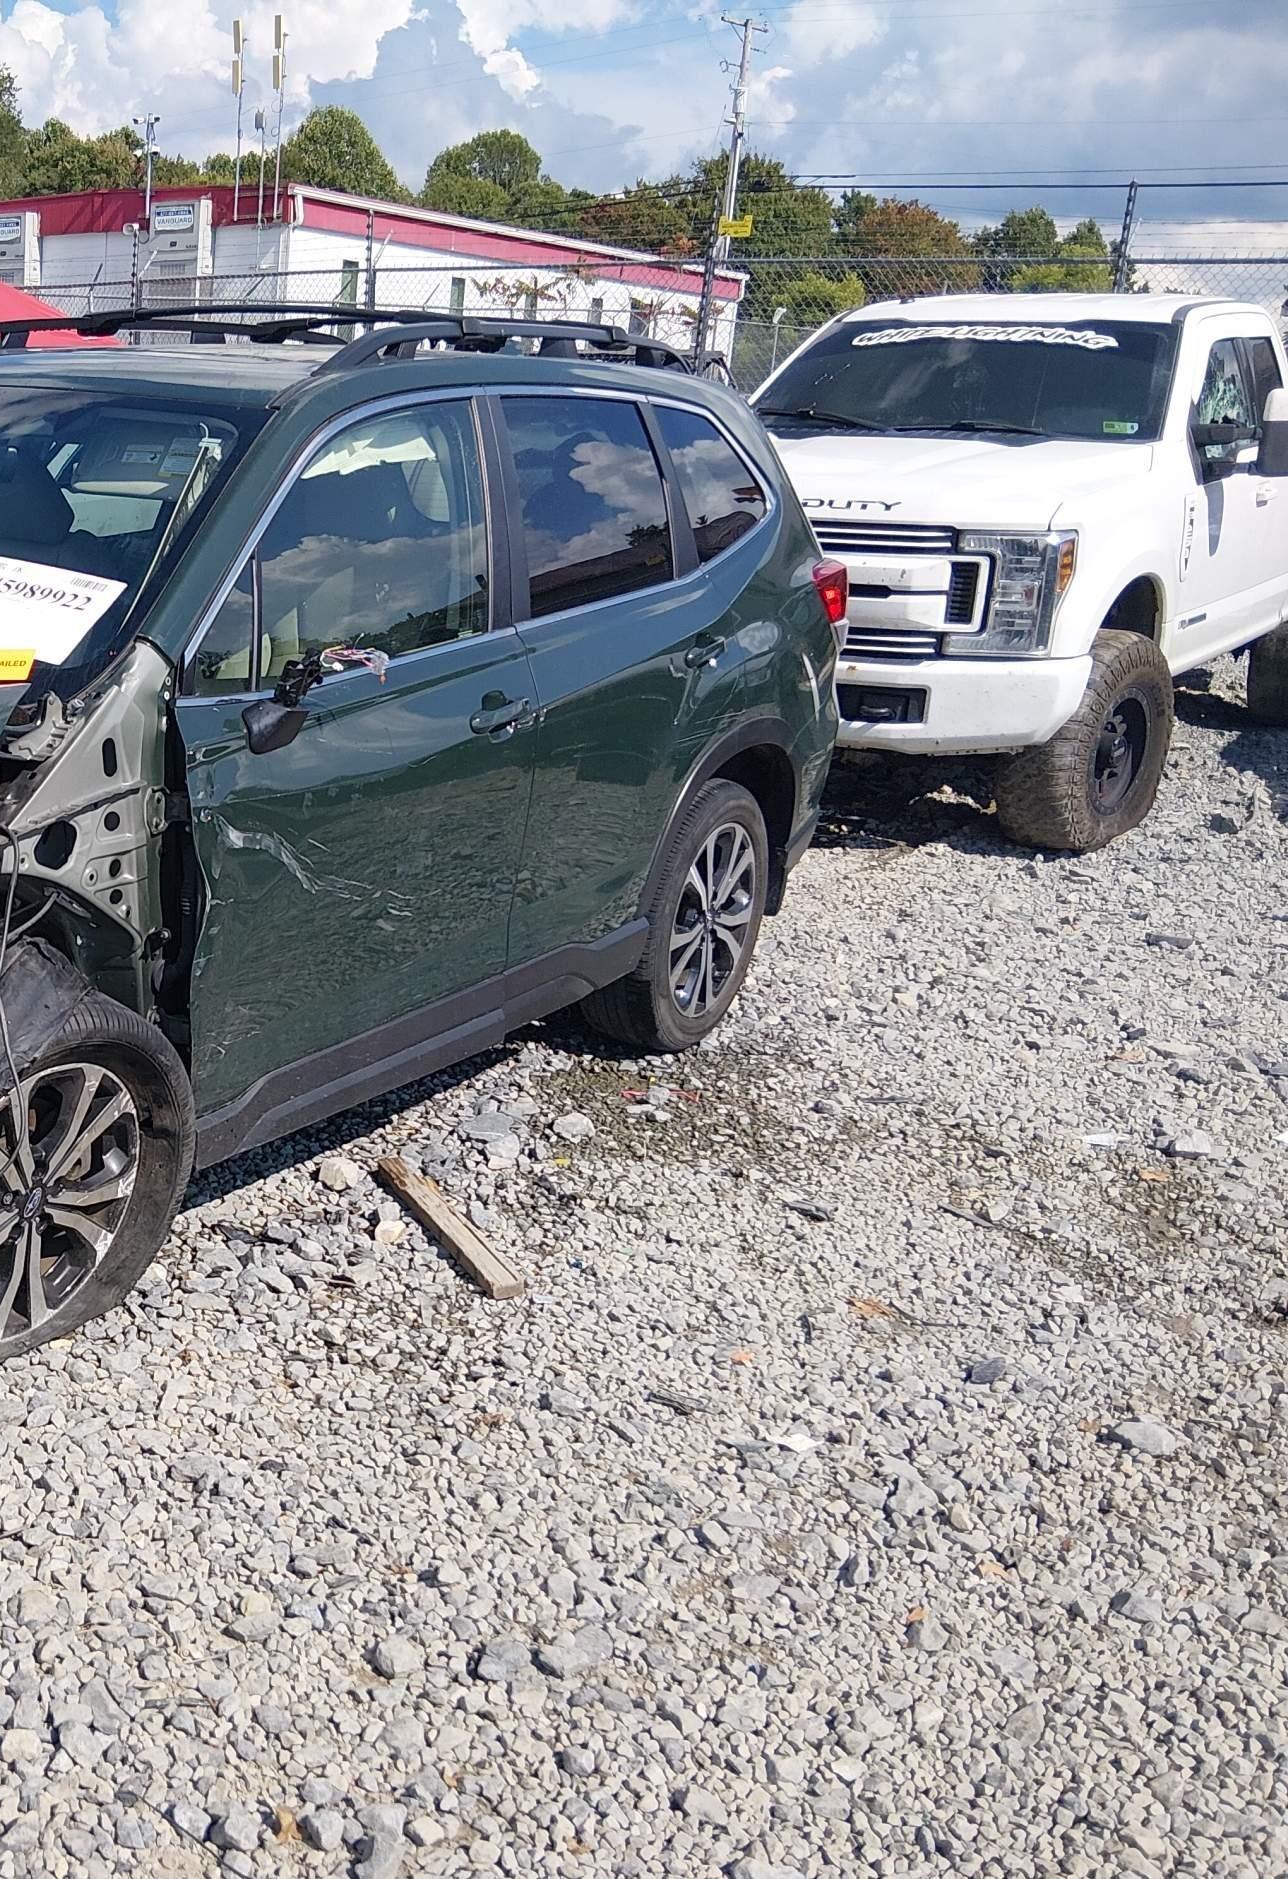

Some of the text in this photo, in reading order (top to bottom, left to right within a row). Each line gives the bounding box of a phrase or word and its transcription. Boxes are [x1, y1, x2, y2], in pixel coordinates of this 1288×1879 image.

[157, 217, 192, 225] VANGUARD
[950, 326, 1119, 349] LIGHTNING
[801, 498, 902, 511] DUTY
